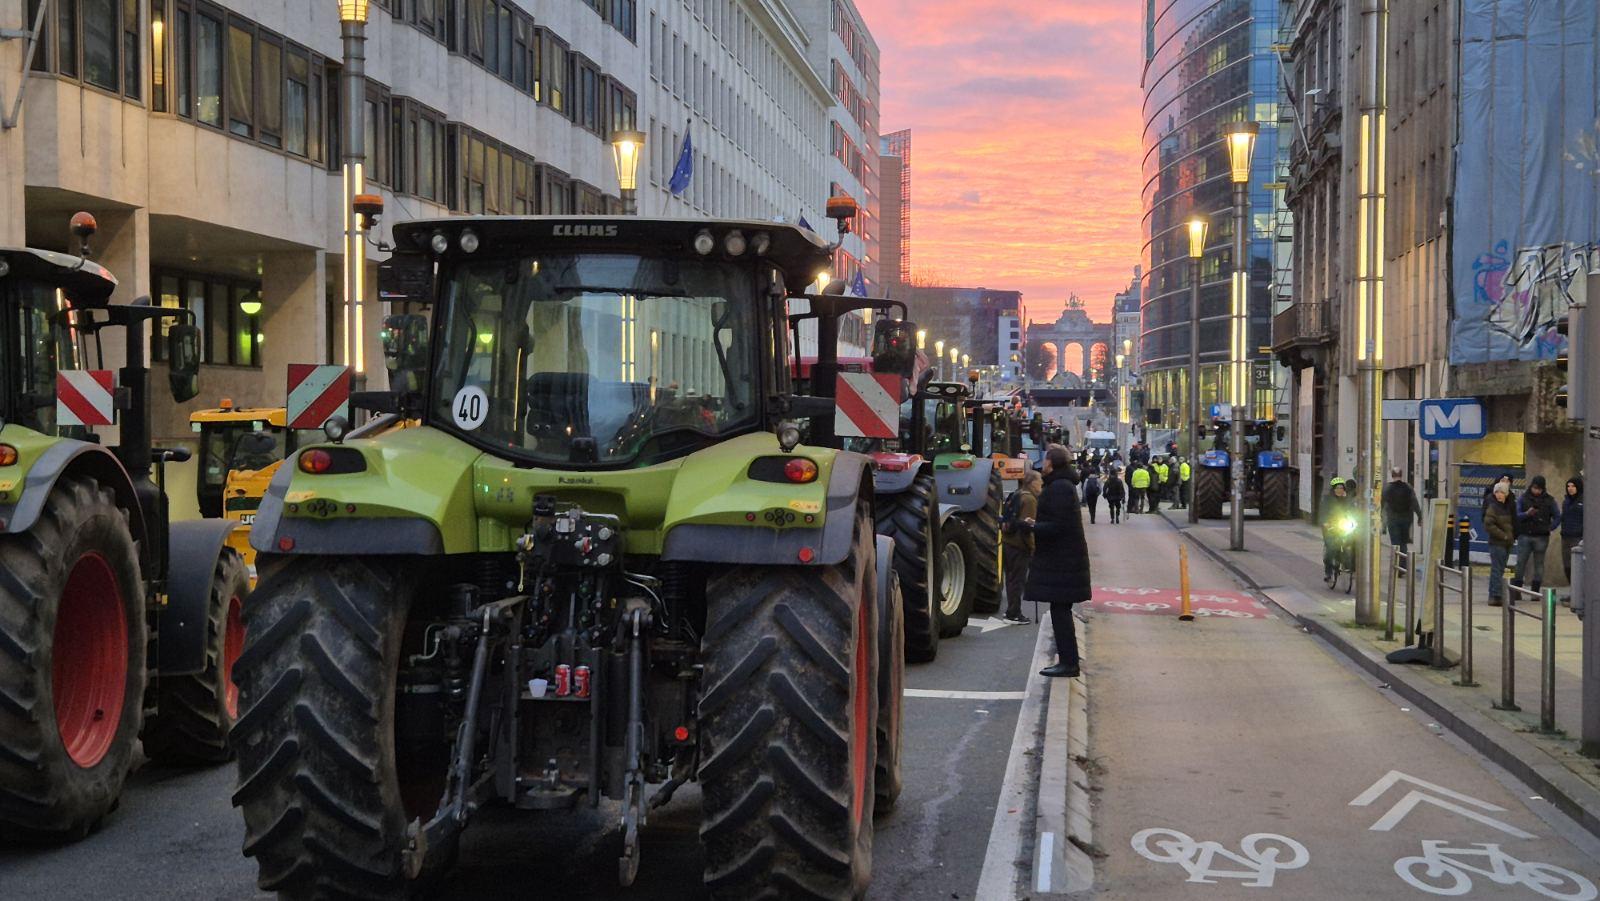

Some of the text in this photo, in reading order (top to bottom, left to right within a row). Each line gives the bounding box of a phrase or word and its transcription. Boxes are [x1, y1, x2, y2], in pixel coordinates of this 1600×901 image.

[553, 224, 618, 236] CLAAS
[459, 394, 481, 421] 40
[1424, 403, 1482, 435] M
